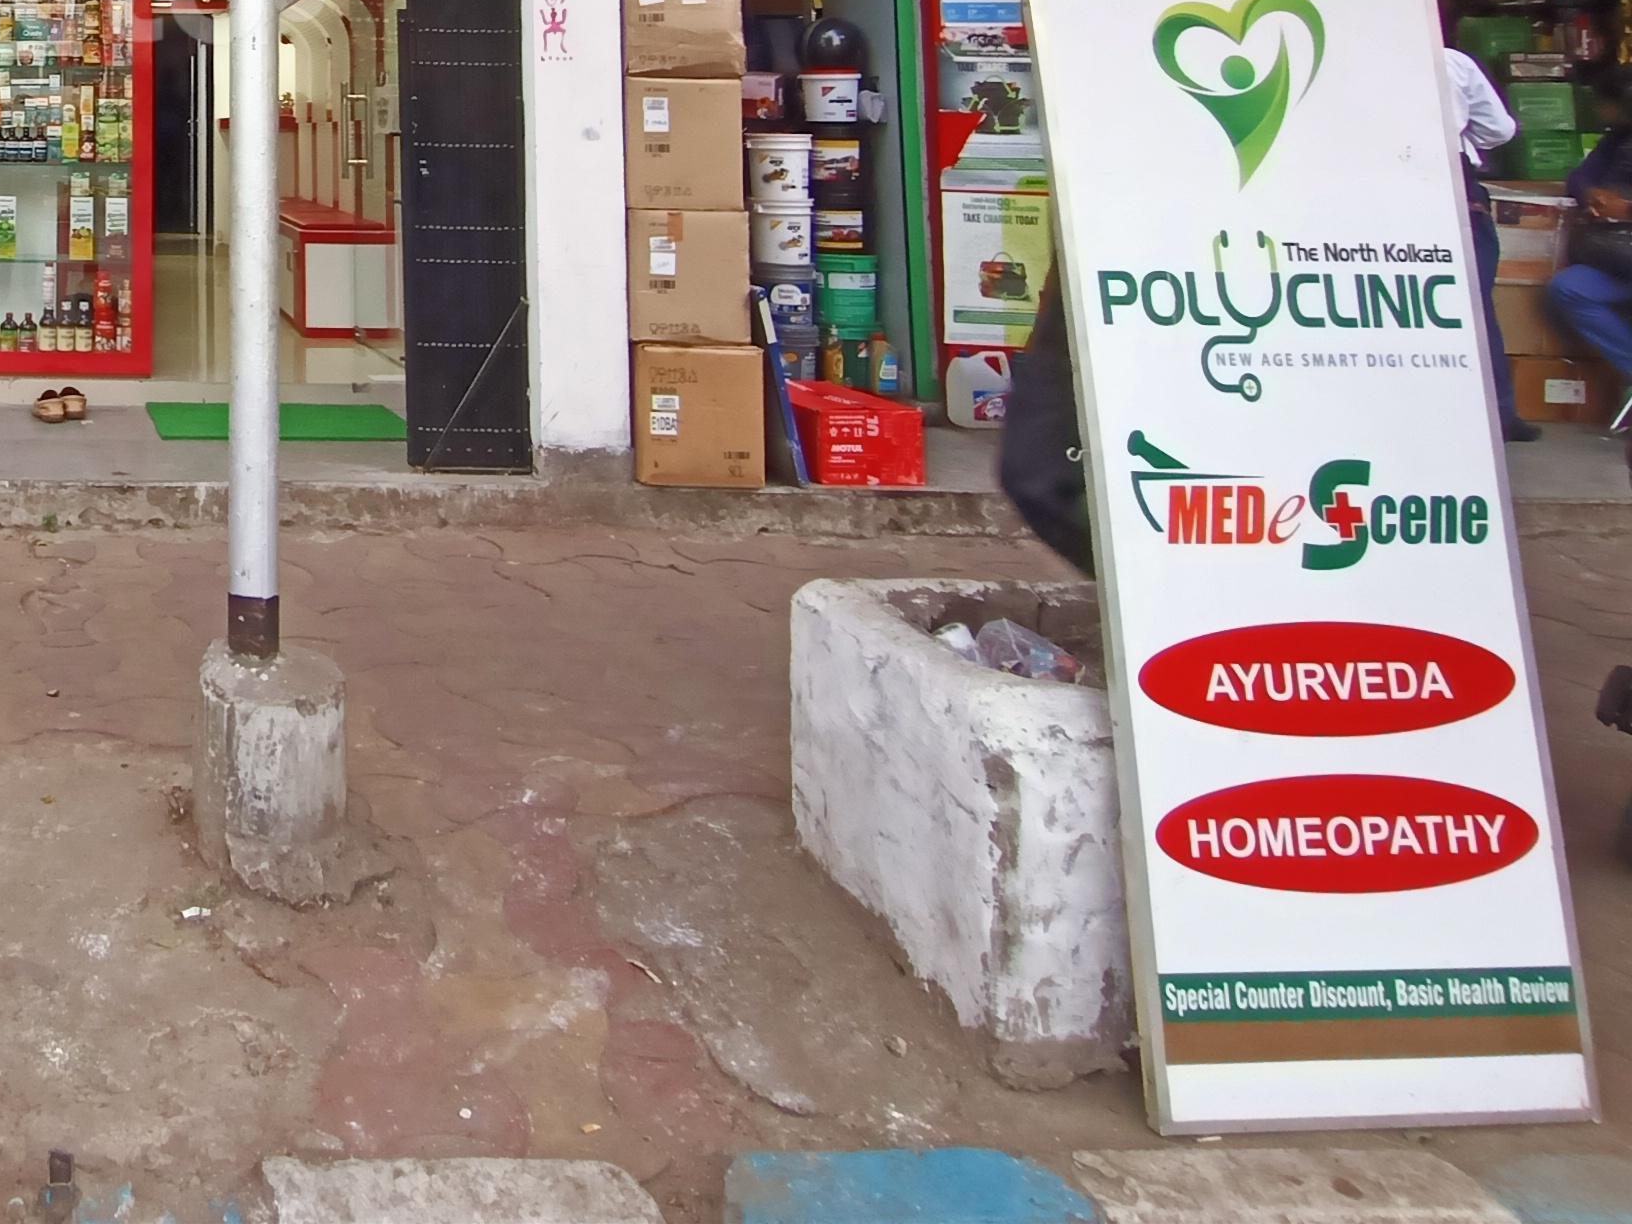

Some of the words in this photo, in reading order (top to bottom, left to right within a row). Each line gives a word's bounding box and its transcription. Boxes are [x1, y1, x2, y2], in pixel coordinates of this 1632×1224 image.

[1282, 242, 1319, 262] The
[1323, 242, 1379, 262] North
[1382, 243, 1453, 263] Kolkata
[1098, 264, 1462, 330] POLYCLINIC
[1215, 352, 1253, 367] NEW
[1261, 352, 1294, 367] AGE
[1301, 353, 1359, 367] SMART
[1366, 353, 1403, 368] DIGI
[1411, 354, 1469, 368] CLINIC
[1206, 662, 1453, 701] AYURVEDA
[1187, 814, 1506, 858] HOMEOPATHY
[1165, 981, 1231, 1017] Special
[1234, 980, 1305, 1009] Counter
[1308, 979, 1392, 1012] Discount,
[1394, 978, 1444, 1006] Basic
[1447, 977, 1506, 1005] Health
[1508, 975, 1570, 1003] Review
